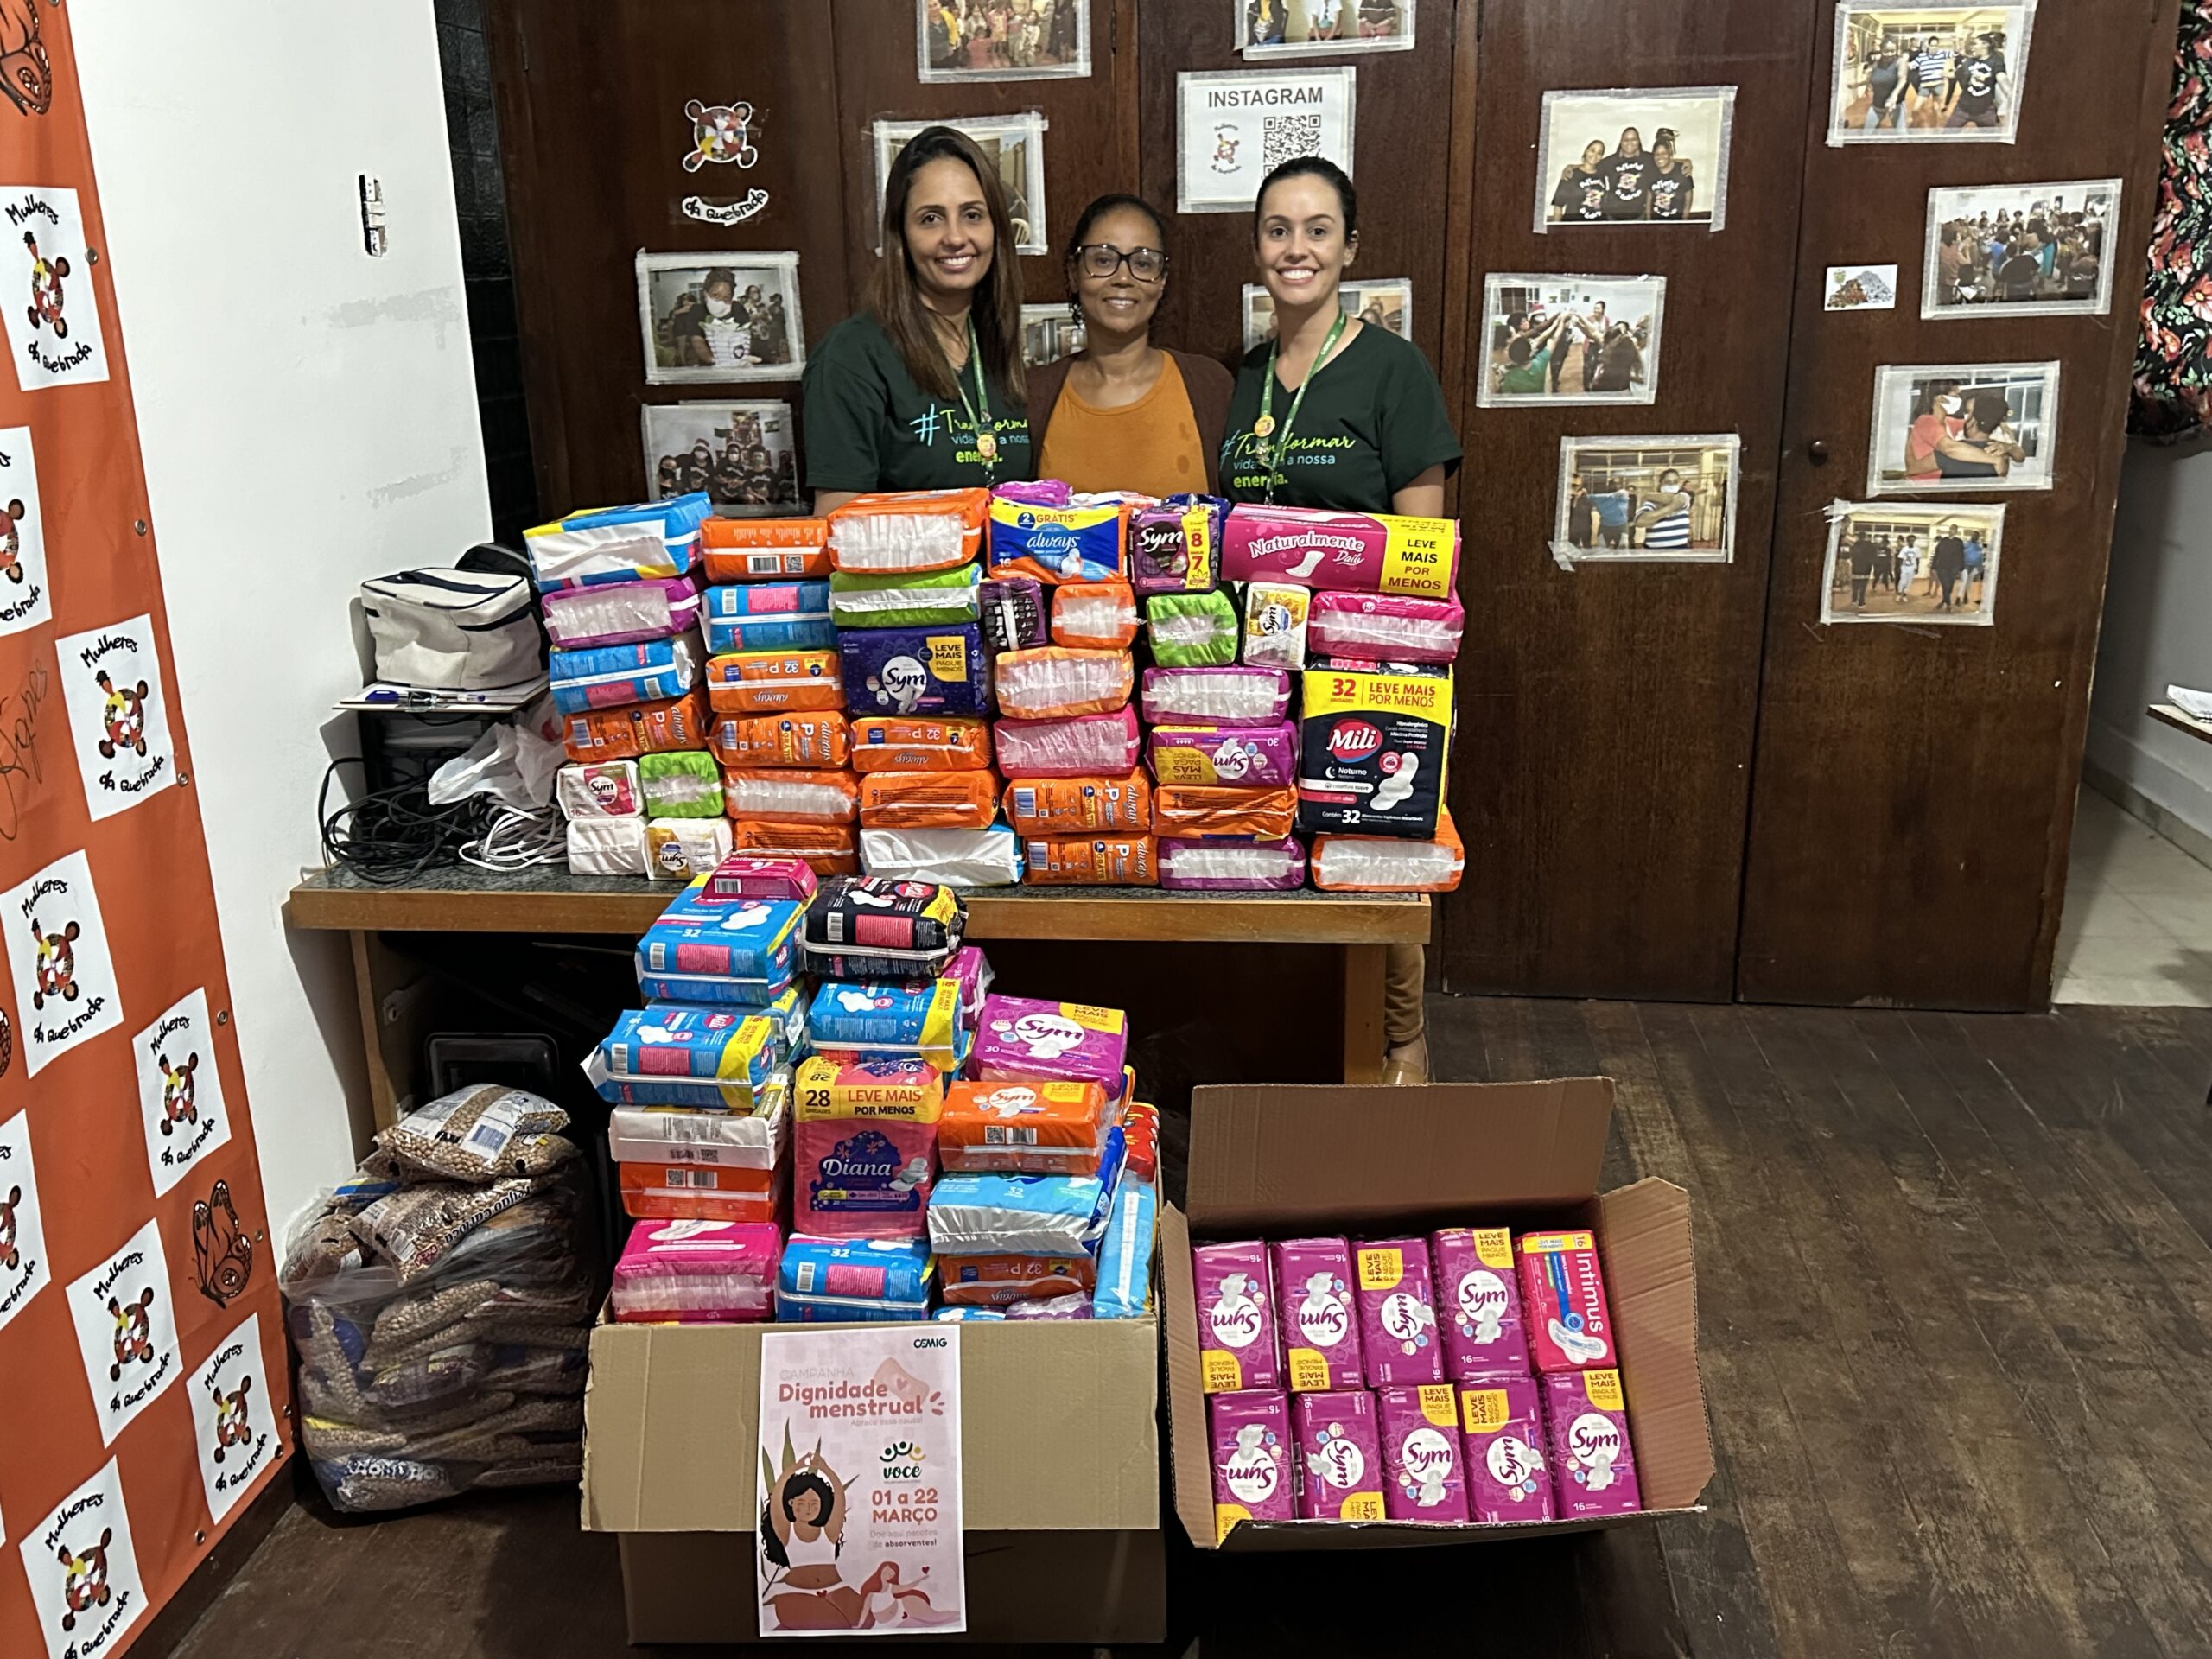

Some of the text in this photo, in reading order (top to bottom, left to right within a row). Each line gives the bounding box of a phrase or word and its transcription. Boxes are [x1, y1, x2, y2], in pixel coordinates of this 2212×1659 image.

[1208, 87, 1323, 108] INSTAGRAM
[5, 194, 58, 226] Mulheres
[706, 190, 766, 221] Quebrada
[43, 341, 92, 373] Quebrada
[999, 435, 1007, 445] a
[1287, 456, 1294, 466] a
[1296, 454, 1336, 466] nossa
[1234, 475, 1288, 489] eneria.
[1022, 512, 1031, 523] 2
[1027, 534, 1079, 550] always
[1136, 527, 1184, 553] Sym
[1191, 532, 1203, 548] 8
[1249, 531, 1365, 558] Naturalmente
[1408, 539, 1436, 550] LEVE
[998, 558, 1012, 567] 16
[1192, 556, 1203, 571] 7
[1333, 550, 1364, 565] Daily
[1402, 551, 1438, 563] MAIS
[1404, 566, 1430, 575] POR
[1388, 576, 1441, 590] MENOS
[1262, 607, 1276, 635] Sym
[80, 635, 138, 668] Mulheres
[785, 663, 799, 674] 32
[885, 667, 925, 692] Sym
[1332, 678, 1357, 697] 32
[1370, 682, 1435, 696] LEVE MAIS
[1369, 693, 1434, 708] POR MENOS
[926, 728, 941, 740] 32
[1326, 728, 1377, 751] Mili
[1213, 751, 1248, 772] Sym
[121, 756, 164, 792] Quebrada
[590, 782, 614, 796] Sym
[1342, 810, 1361, 823] 32
[661, 852, 686, 867] Sym
[21, 878, 68, 918] Mulheres
[682, 929, 702, 938] 32
[48, 995, 105, 1043] Quebrada
[1074, 1009, 1108, 1018] MAIS
[149, 1014, 190, 1056] Mulheres
[1017, 1020, 1083, 1039] Sym
[805, 1090, 831, 1108] 28
[848, 1090, 922, 1103] LEVE MAIS
[995, 1092, 1035, 1103] Sym
[855, 1105, 915, 1115] POR MENOS
[176, 1117, 215, 1165] Quebrada
[822, 1159, 891, 1176] Diana
[1577, 1236, 1586, 1247] 16
[830, 1248, 849, 1257] 32
[1249, 1254, 1262, 1262] 16
[93, 1251, 143, 1300] Mulheres
[1027, 1263, 1042, 1274] 32
[1460, 1283, 1506, 1313] Sym
[1575, 1253, 1604, 1333] Intimus
[1213, 1304, 1259, 1334] Sym
[1300, 1303, 1345, 1333] Sym
[1393, 1295, 1412, 1336] Sym
[913, 1338, 947, 1348] CEMIG
[204, 1341, 243, 1390] Mulheres
[1461, 1355, 1472, 1363] 16
[124, 1351, 170, 1408] Quebrada
[779, 1367, 854, 1381] CAMPANHA
[1433, 1369, 1440, 1380] 16
[779, 1379, 887, 1405] Dignidade
[810, 1395, 923, 1418] menstrual
[1268, 1405, 1280, 1414] 16
[1304, 1396, 1313, 1408] 16
[1470, 1395, 1479, 1424] LEVE
[1572, 1427, 1618, 1458] Sym
[230, 1433, 267, 1486] Quebrada
[1327, 1441, 1352, 1486] Sym
[1408, 1442, 1452, 1472] Sym
[1499, 1438, 1525, 1483] Sym
[883, 1462, 922, 1479] você
[1228, 1458, 1274, 1489] Sym
[872, 1488, 938, 1506] 01 a 22
[1573, 1502, 1586, 1510] 16
[46, 1492, 104, 1550] Mulheres
[873, 1508, 938, 1525] MARÇO
[885, 1539, 937, 1548] absorventes!
[81, 1591, 130, 1656] Quebrada
